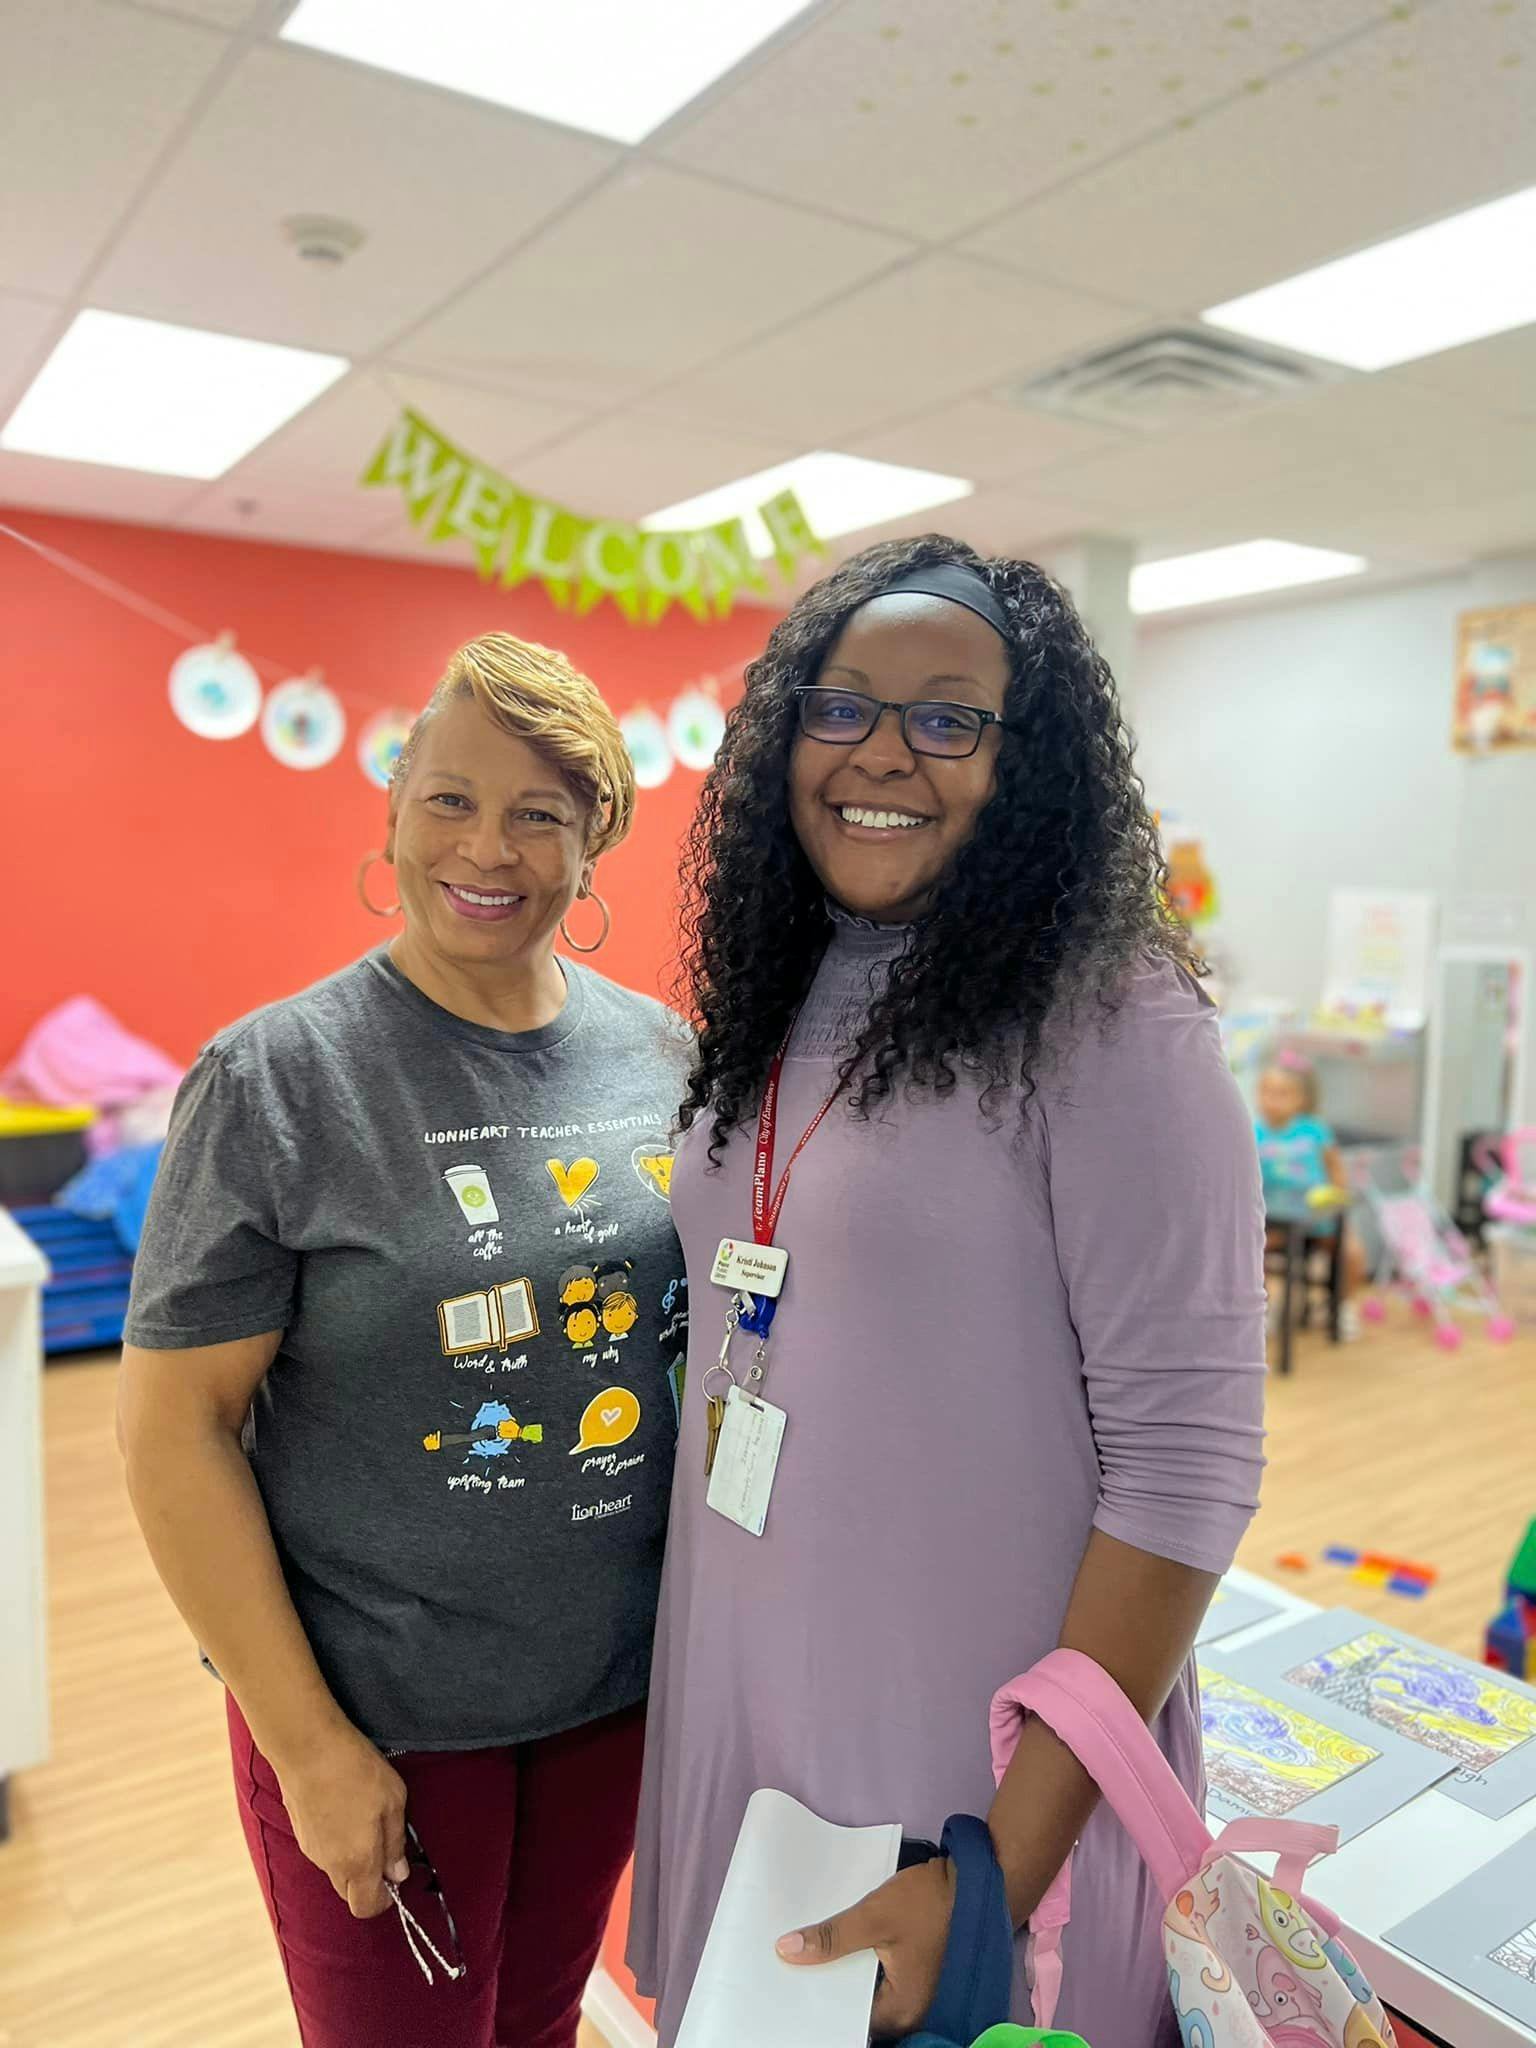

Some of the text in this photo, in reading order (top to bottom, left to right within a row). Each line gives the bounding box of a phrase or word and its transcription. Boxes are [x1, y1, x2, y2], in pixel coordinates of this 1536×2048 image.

[424, 1113, 662, 1144] LIONHEART TEACHER ESSENTIALS
[758, 1126, 769, 1145] City
[486, 1228, 504, 1242] the
[555, 1219, 592, 1235] a heart
[597, 1223, 619, 1244] gold
[473, 1243, 503, 1261] coffee
[453, 1355, 487, 1370] Word
[501, 1354, 528, 1371] truth
[582, 1349, 619, 1368] my why
[581, 1452, 617, 1473] prayer
[447, 1471, 525, 1495] uplifting team
[1207, 1787, 1257, 1817] Dami
